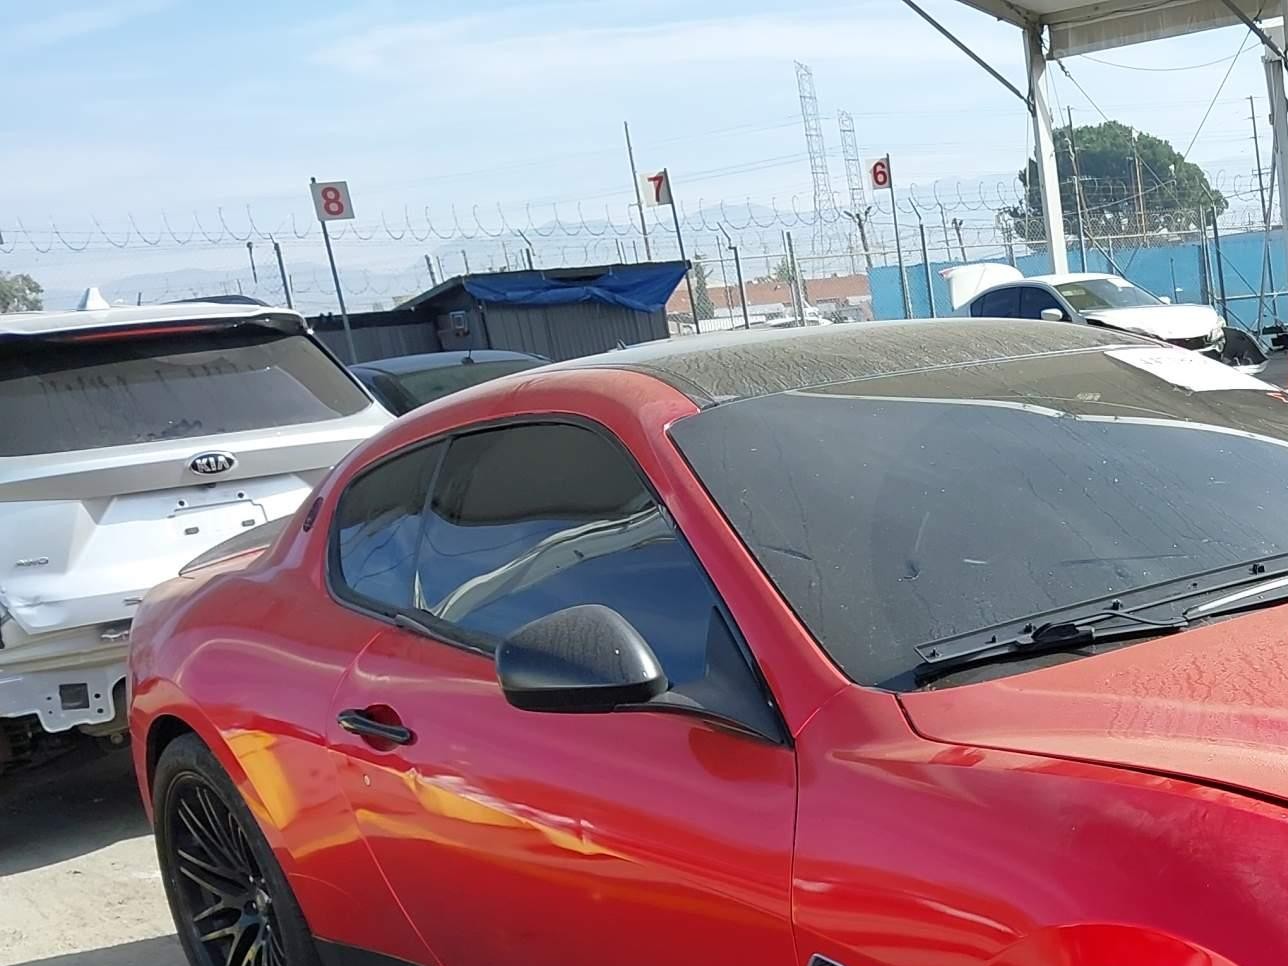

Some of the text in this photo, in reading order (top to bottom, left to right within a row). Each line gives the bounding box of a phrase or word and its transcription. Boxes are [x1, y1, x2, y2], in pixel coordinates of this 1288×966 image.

[872, 161, 888, 186] 6
[321, 186, 344, 216] 8
[647, 175, 664, 203] 7
[195, 455, 230, 474] KIA
